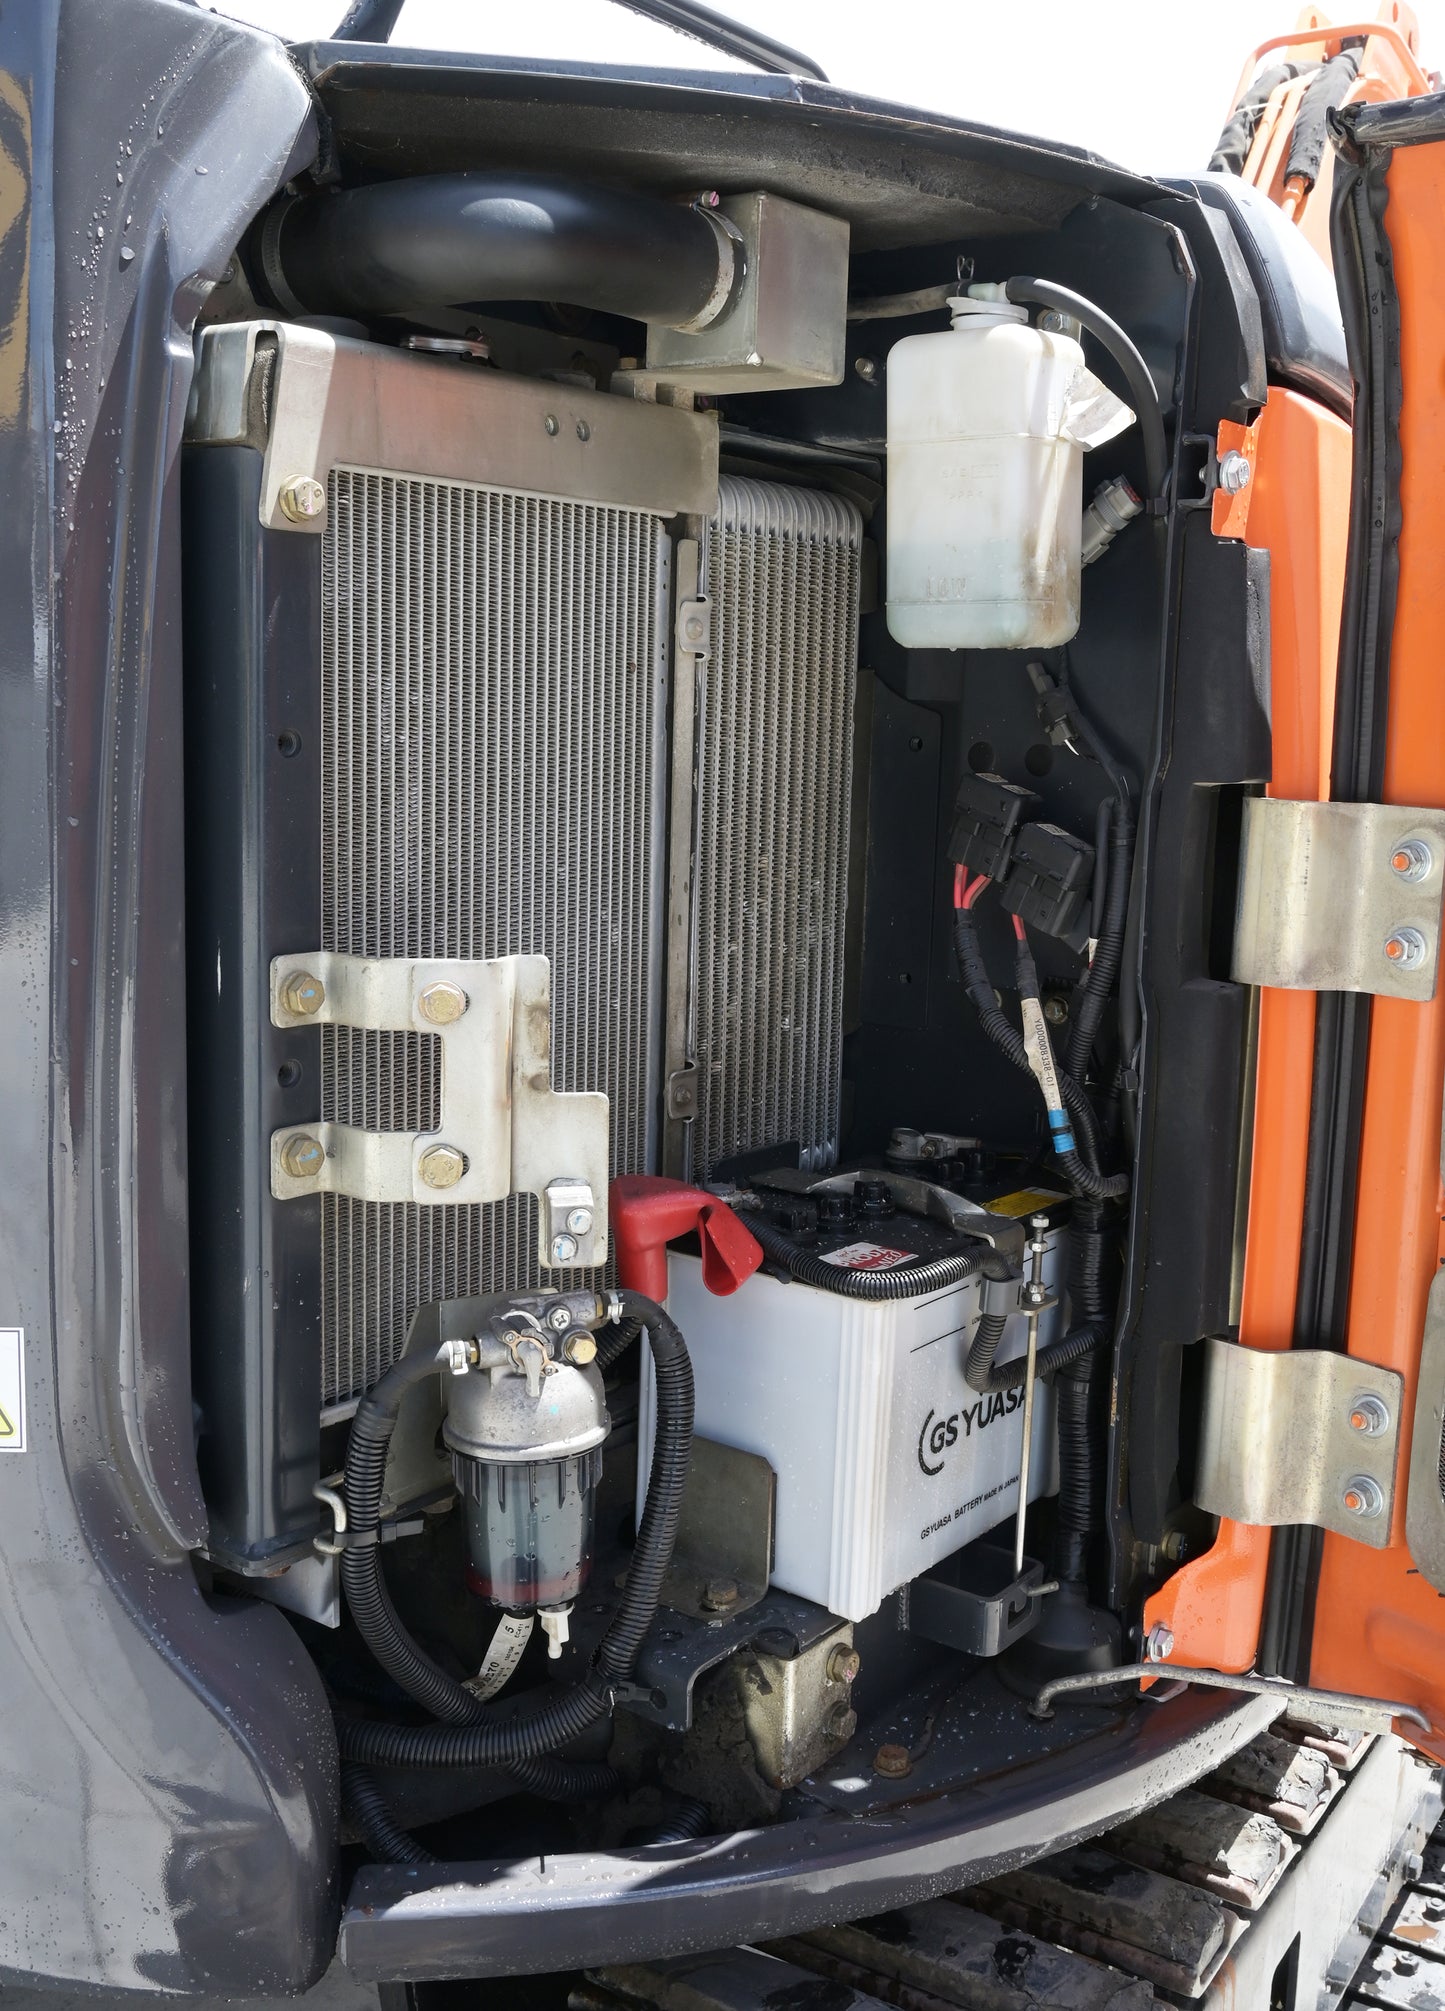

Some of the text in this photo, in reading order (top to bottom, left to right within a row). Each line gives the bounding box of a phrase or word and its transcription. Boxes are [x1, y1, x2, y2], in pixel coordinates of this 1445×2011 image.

[954, 1494, 984, 1519] BATTERY
[983, 1487, 997, 1501] MADE
[1003, 1475, 1020, 1489] JAPAN
[505, 1625, 514, 1634] 5
